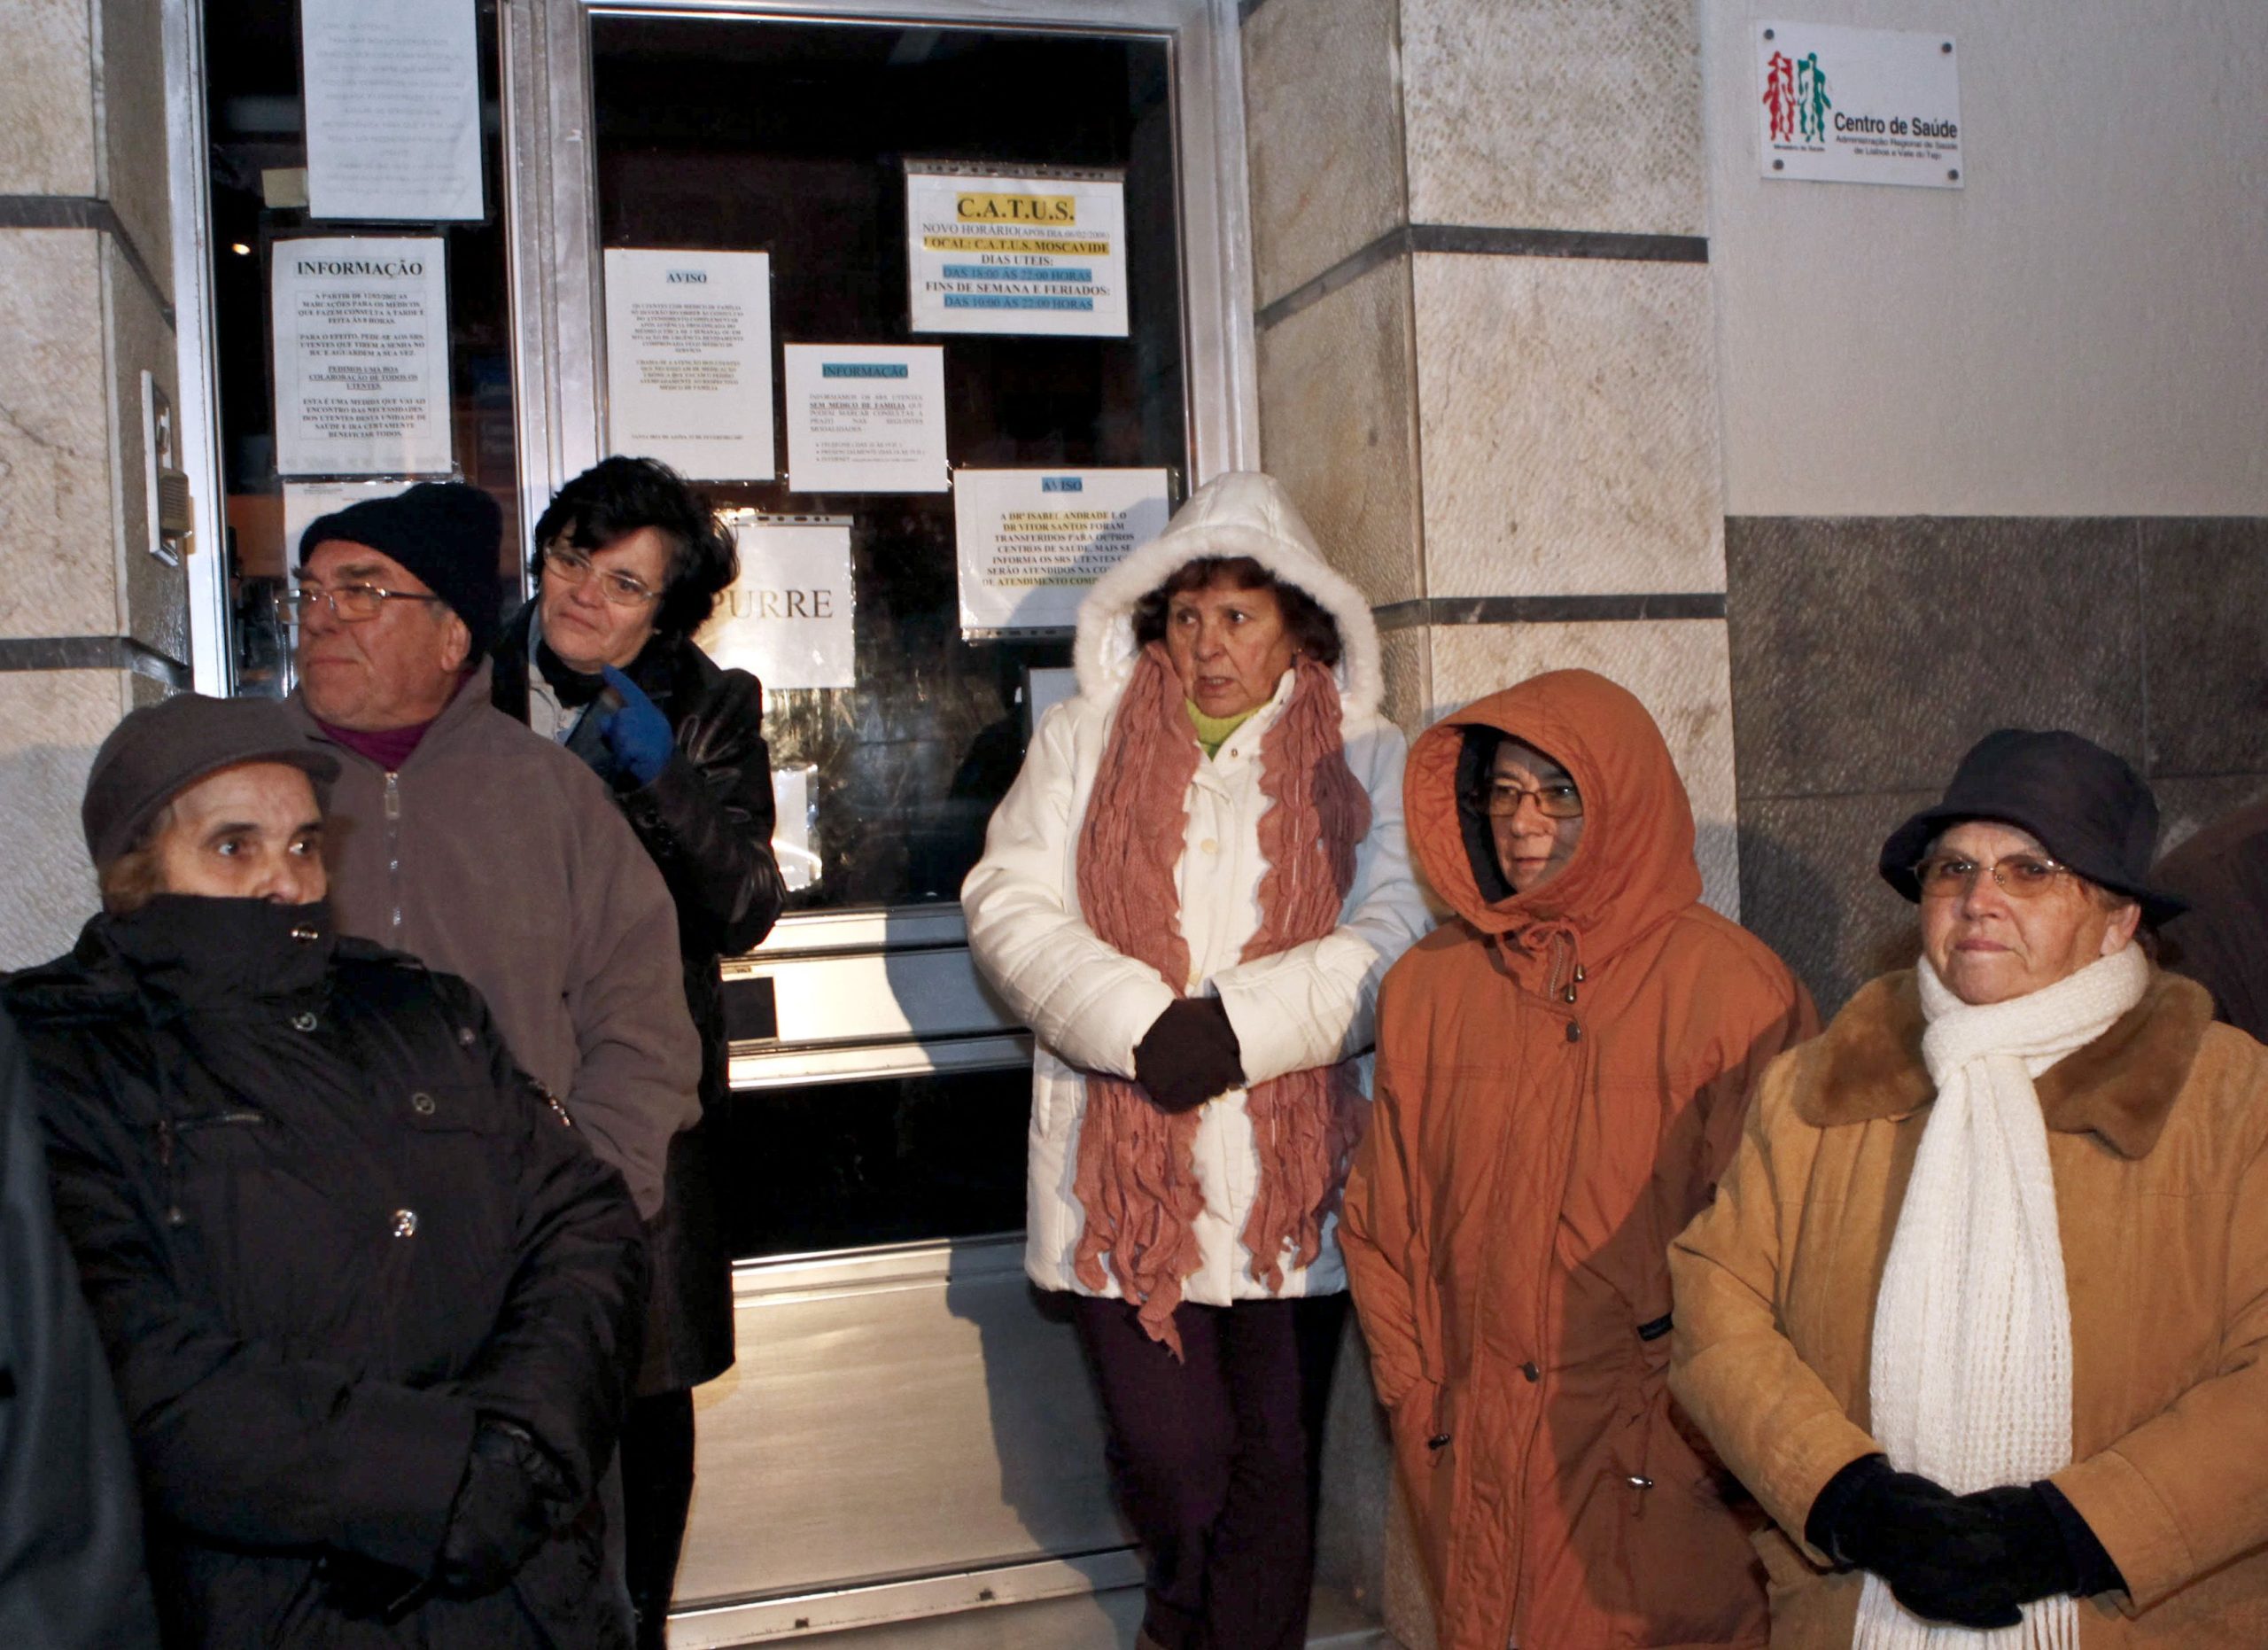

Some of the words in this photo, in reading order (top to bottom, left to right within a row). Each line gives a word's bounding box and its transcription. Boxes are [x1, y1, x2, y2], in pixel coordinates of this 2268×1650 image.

[1834, 112, 1885, 133] Centro
[1890, 116, 1907, 135] de
[1912, 117, 1957, 138] Saúde
[1891, 138, 1922, 149] Regional
[957, 198, 1075, 222] C.A.T.U.S.
[923, 223, 959, 234] NOVO
[923, 237, 971, 249] LOCAL:
[975, 239, 1032, 252] C.A.T.U.S.
[1035, 240, 1108, 253] MOSCAVIDE
[982, 254, 1011, 265] DIAS
[297, 259, 423, 279] INFORMAÇÃO
[666, 272, 707, 284] AVISO
[944, 268, 967, 277] DAS
[1052, 271, 1091, 282] HORAS
[926, 281, 954, 292] FINS
[957, 283, 973, 292] DE
[976, 284, 1029, 294] SEMANA
[1033, 284, 1039, 294] E
[1045, 284, 1111, 296] FERIADOS:
[944, 296, 968, 307] DAS
[1052, 300, 1093, 310] HORAS
[1043, 480, 1083, 491] AVISO
[1028, 512, 1060, 521] ISABEL
[1064, 511, 1107, 520] ANDRADE
[1090, 522, 1124, 531] FORAM
[987, 566, 1020, 575] SERÃO
[998, 577, 1068, 586] ATENDIMENTO
